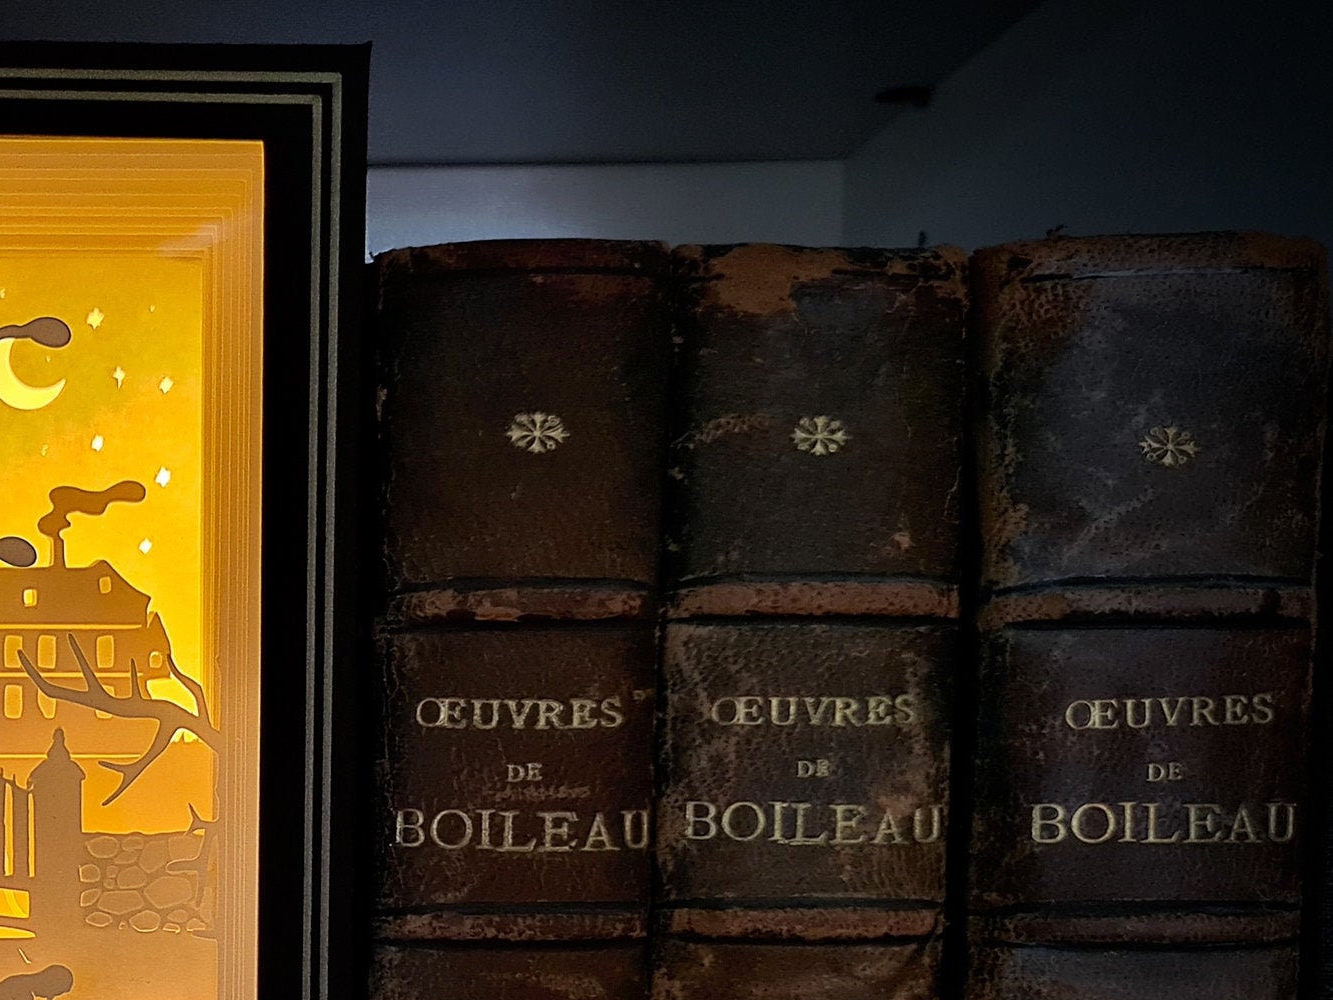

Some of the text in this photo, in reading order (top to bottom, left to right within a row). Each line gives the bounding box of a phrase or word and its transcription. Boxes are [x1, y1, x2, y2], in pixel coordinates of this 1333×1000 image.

[416, 697, 623, 730] ŒUVRES
[712, 695, 916, 727] ŒUVRES
[1065, 692, 1275, 730] ŒUVRES
[506, 762, 543, 782] DE
[796, 759, 832, 779] DE
[1146, 762, 1184, 782] DE
[395, 808, 650, 852] BOILEAU
[685, 800, 944, 846] BOILEAU
[1029, 800, 1298, 844] BOILEAU
